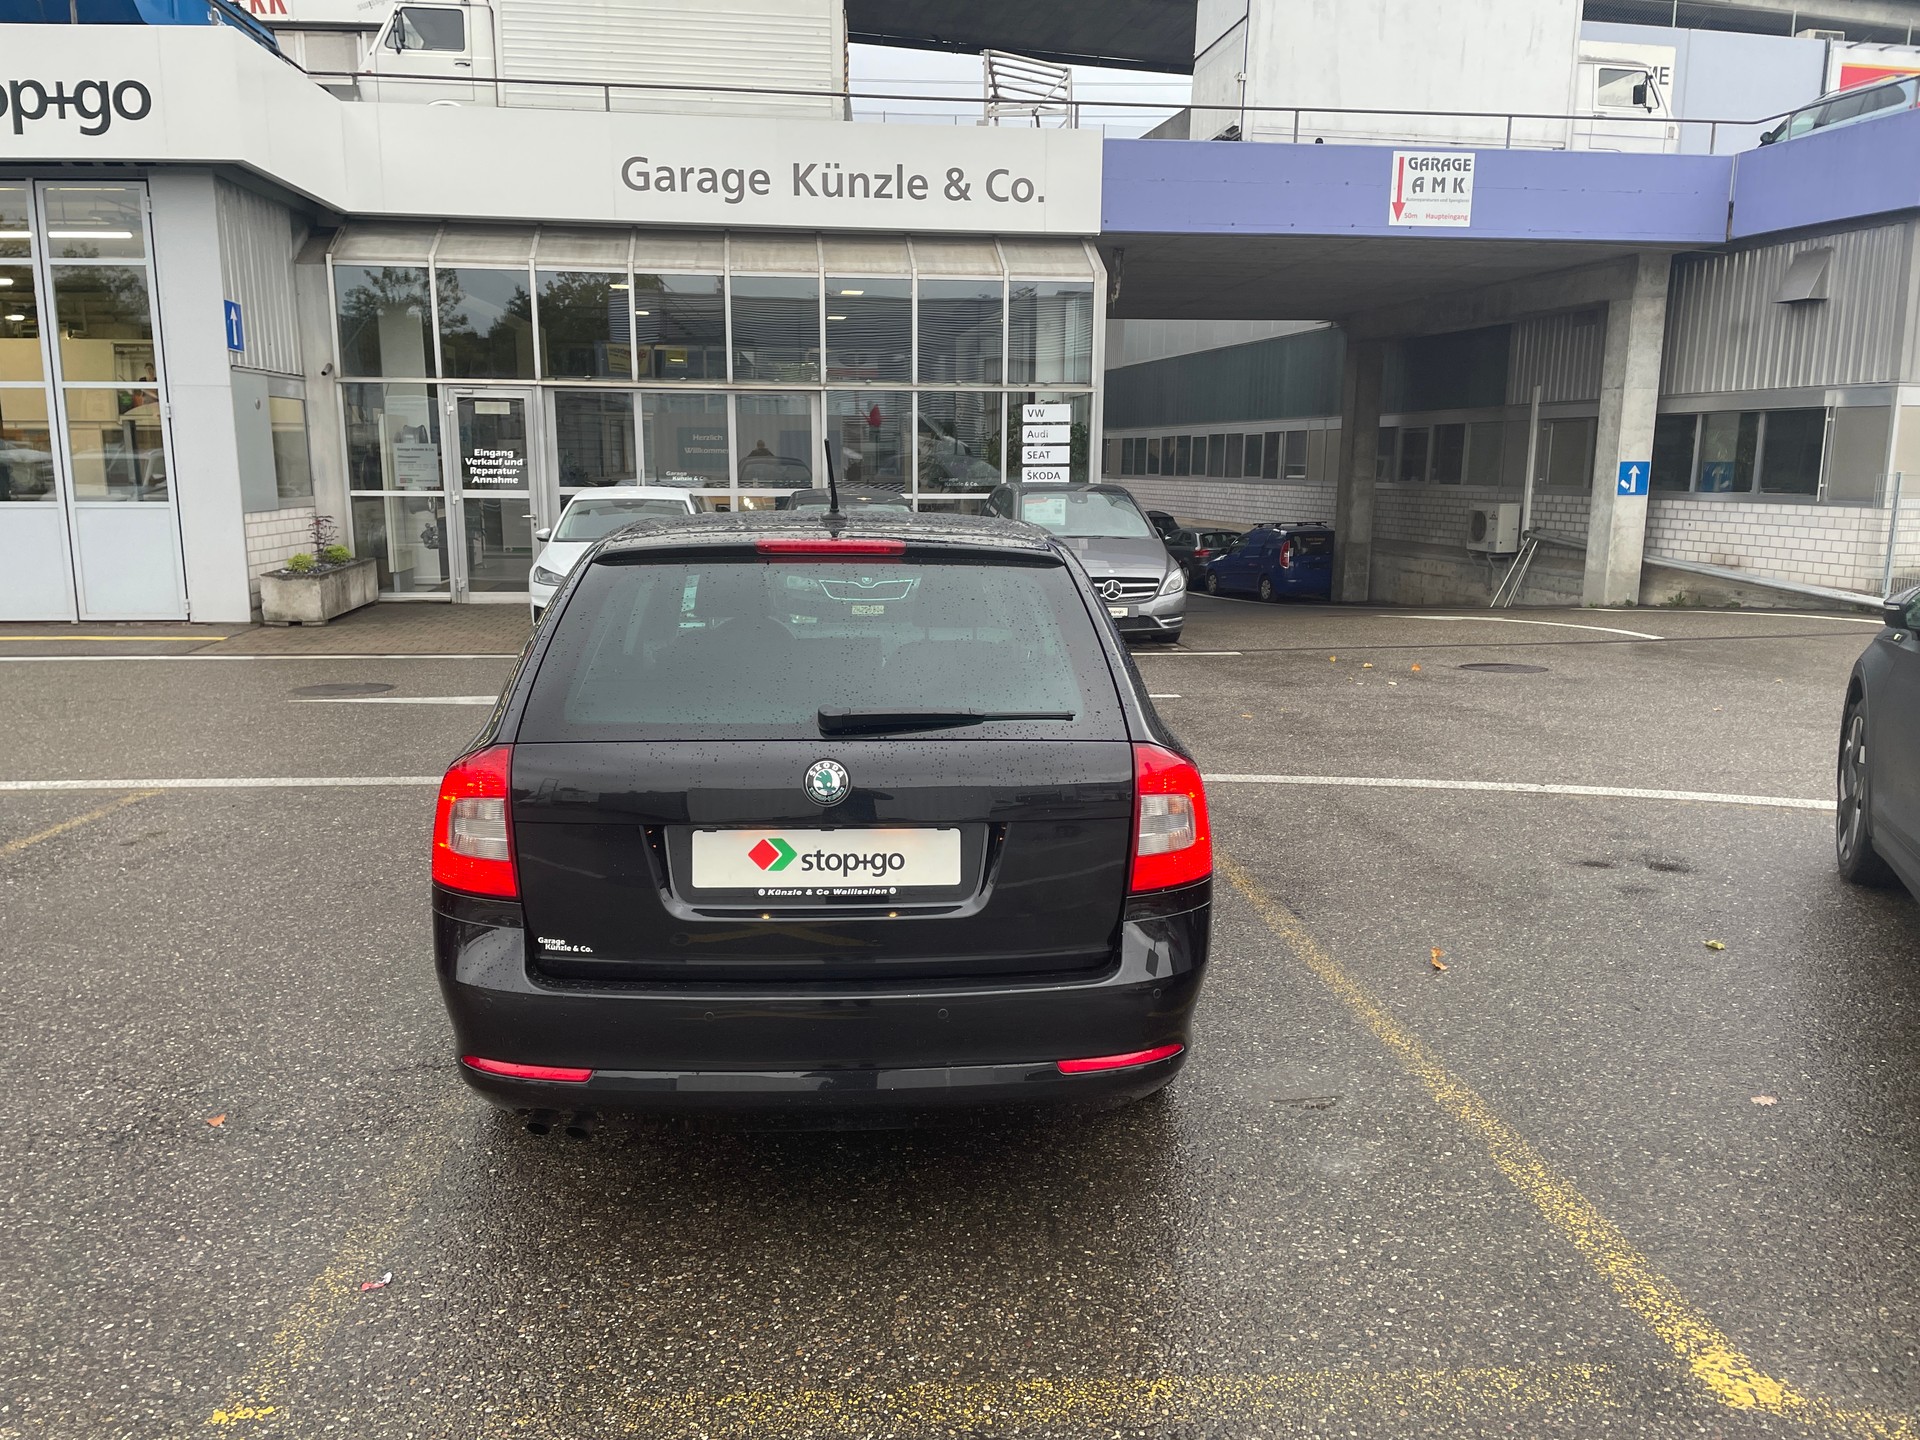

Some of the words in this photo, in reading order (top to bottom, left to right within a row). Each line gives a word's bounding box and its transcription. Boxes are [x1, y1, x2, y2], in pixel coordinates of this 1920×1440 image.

[0, 80, 152, 136] p+go
[1408, 157, 1472, 172] GARAGE
[621, 156, 771, 204] Garage
[793, 163, 929, 200] Künzle
[943, 167, 972, 202] &
[985, 169, 1045, 203] Co.
[1425, 213, 1468, 221] Haupteingang
[1027, 409, 1045, 418] VW
[1027, 430, 1049, 438] Audi
[474, 448, 514, 458] Eingang
[1027, 451, 1051, 459] SEAT
[465, 457, 503, 466] Verkauf
[504, 458, 523, 466] und
[469, 466, 520, 476] Reparatur-
[1027, 469, 1061, 480] ŠKODA
[471, 476, 519, 484] Annahme
[801, 849, 906, 877] stop+go
[767, 888, 803, 896] Künzle
[805, 888, 813, 896] &
[816, 888, 830, 896] Co
[833, 887, 888, 896] Wallisellen
[537, 936, 566, 945] Garage
[545, 943, 572, 952] Künzle
[572, 944, 580, 952] &
[580, 945, 593, 953] Co.
